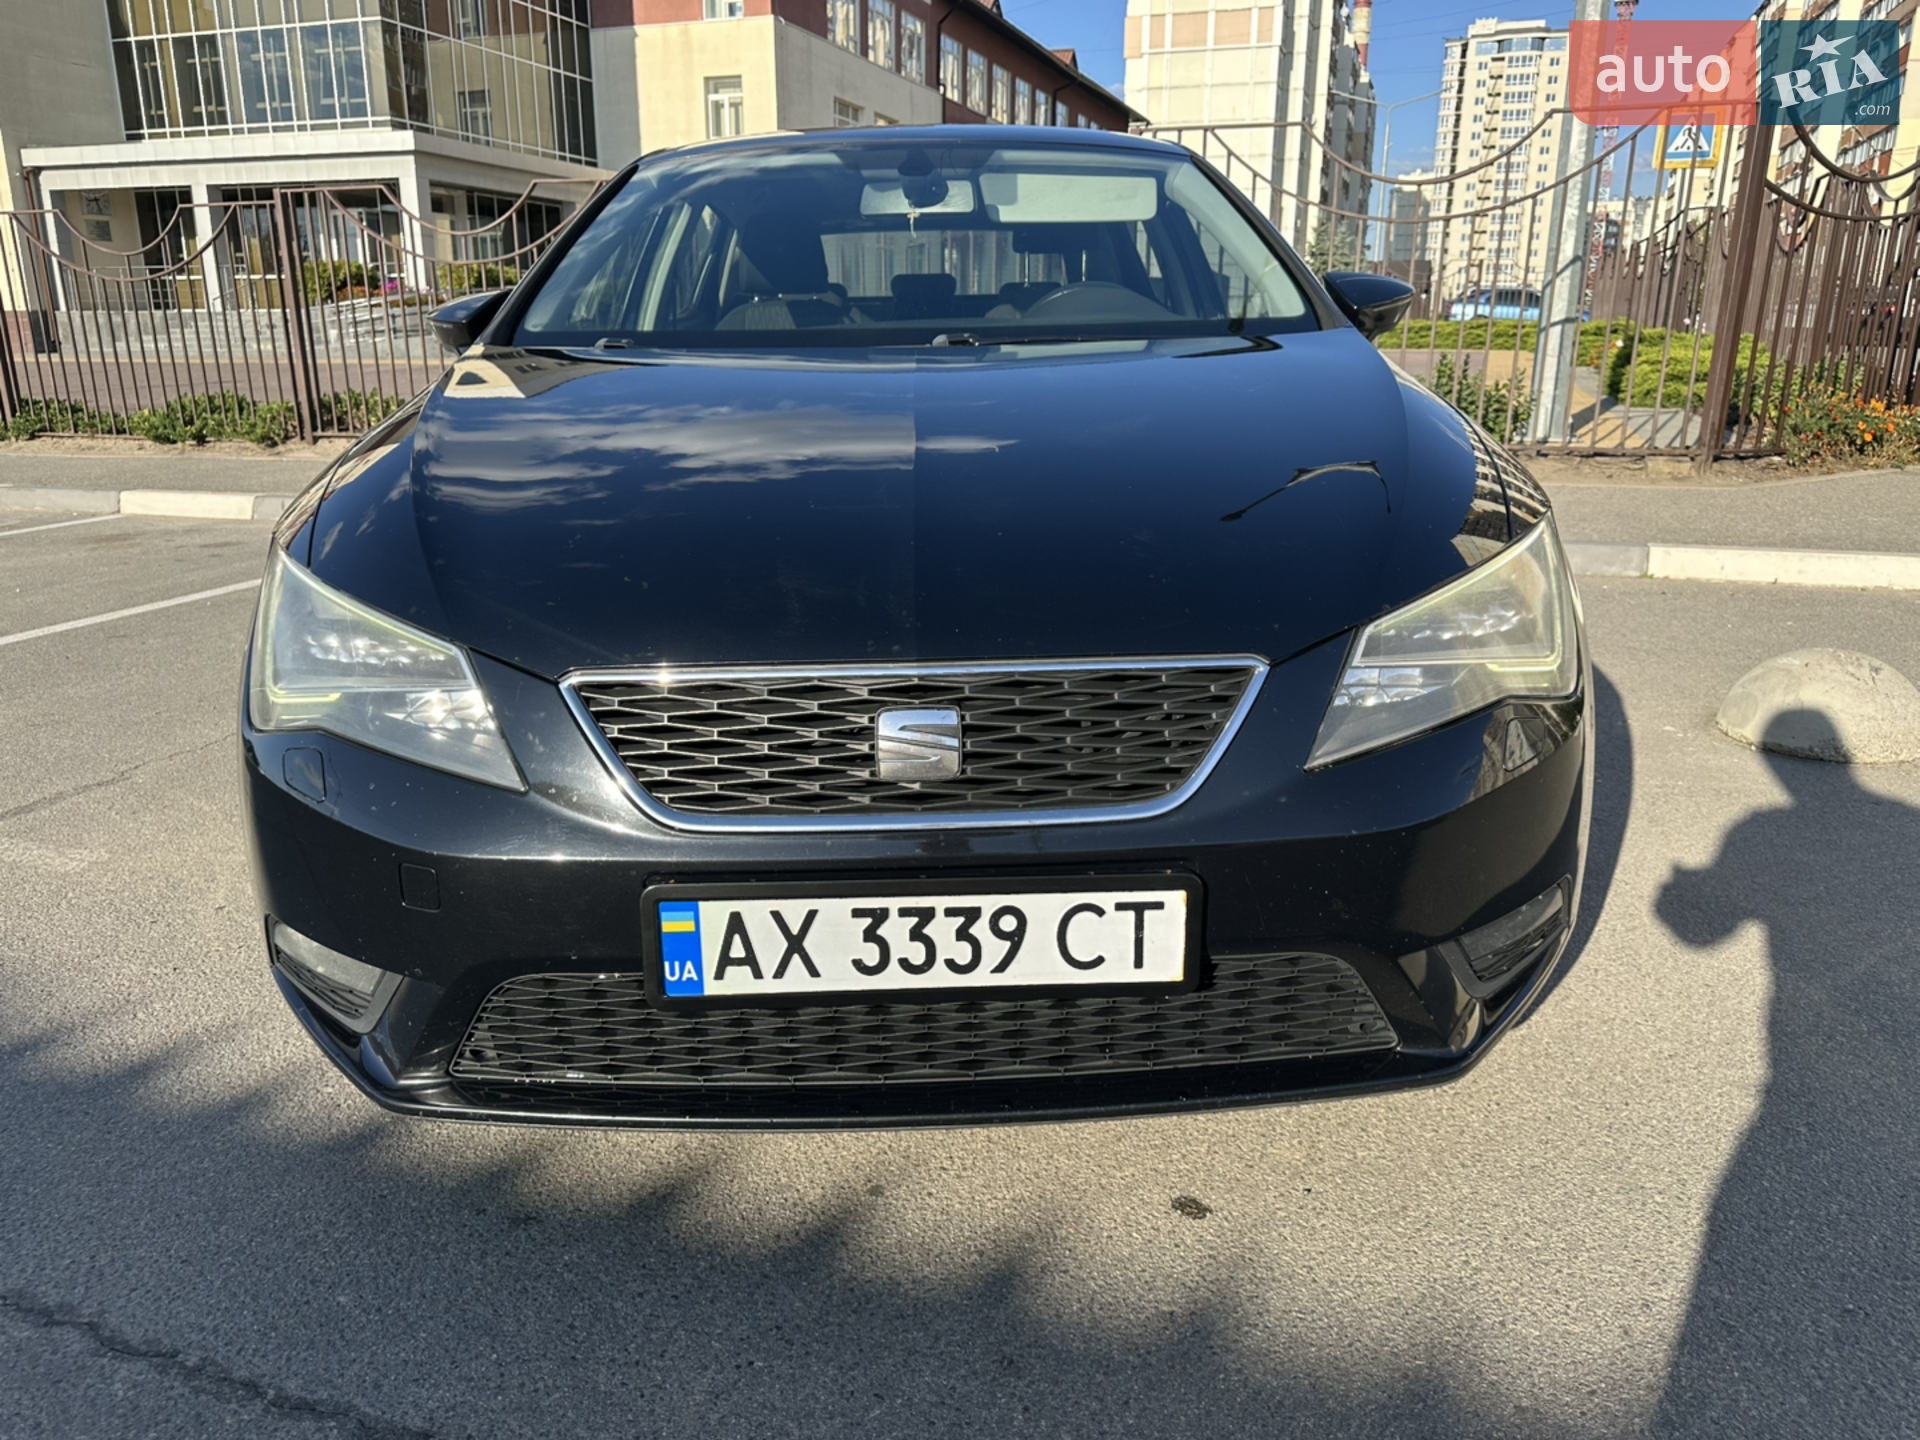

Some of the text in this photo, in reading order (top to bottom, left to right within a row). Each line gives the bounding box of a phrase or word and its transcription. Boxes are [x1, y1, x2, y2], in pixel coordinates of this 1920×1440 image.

[713, 900, 1165, 981] AX 3339 CT
[663, 960, 699, 982] UA
